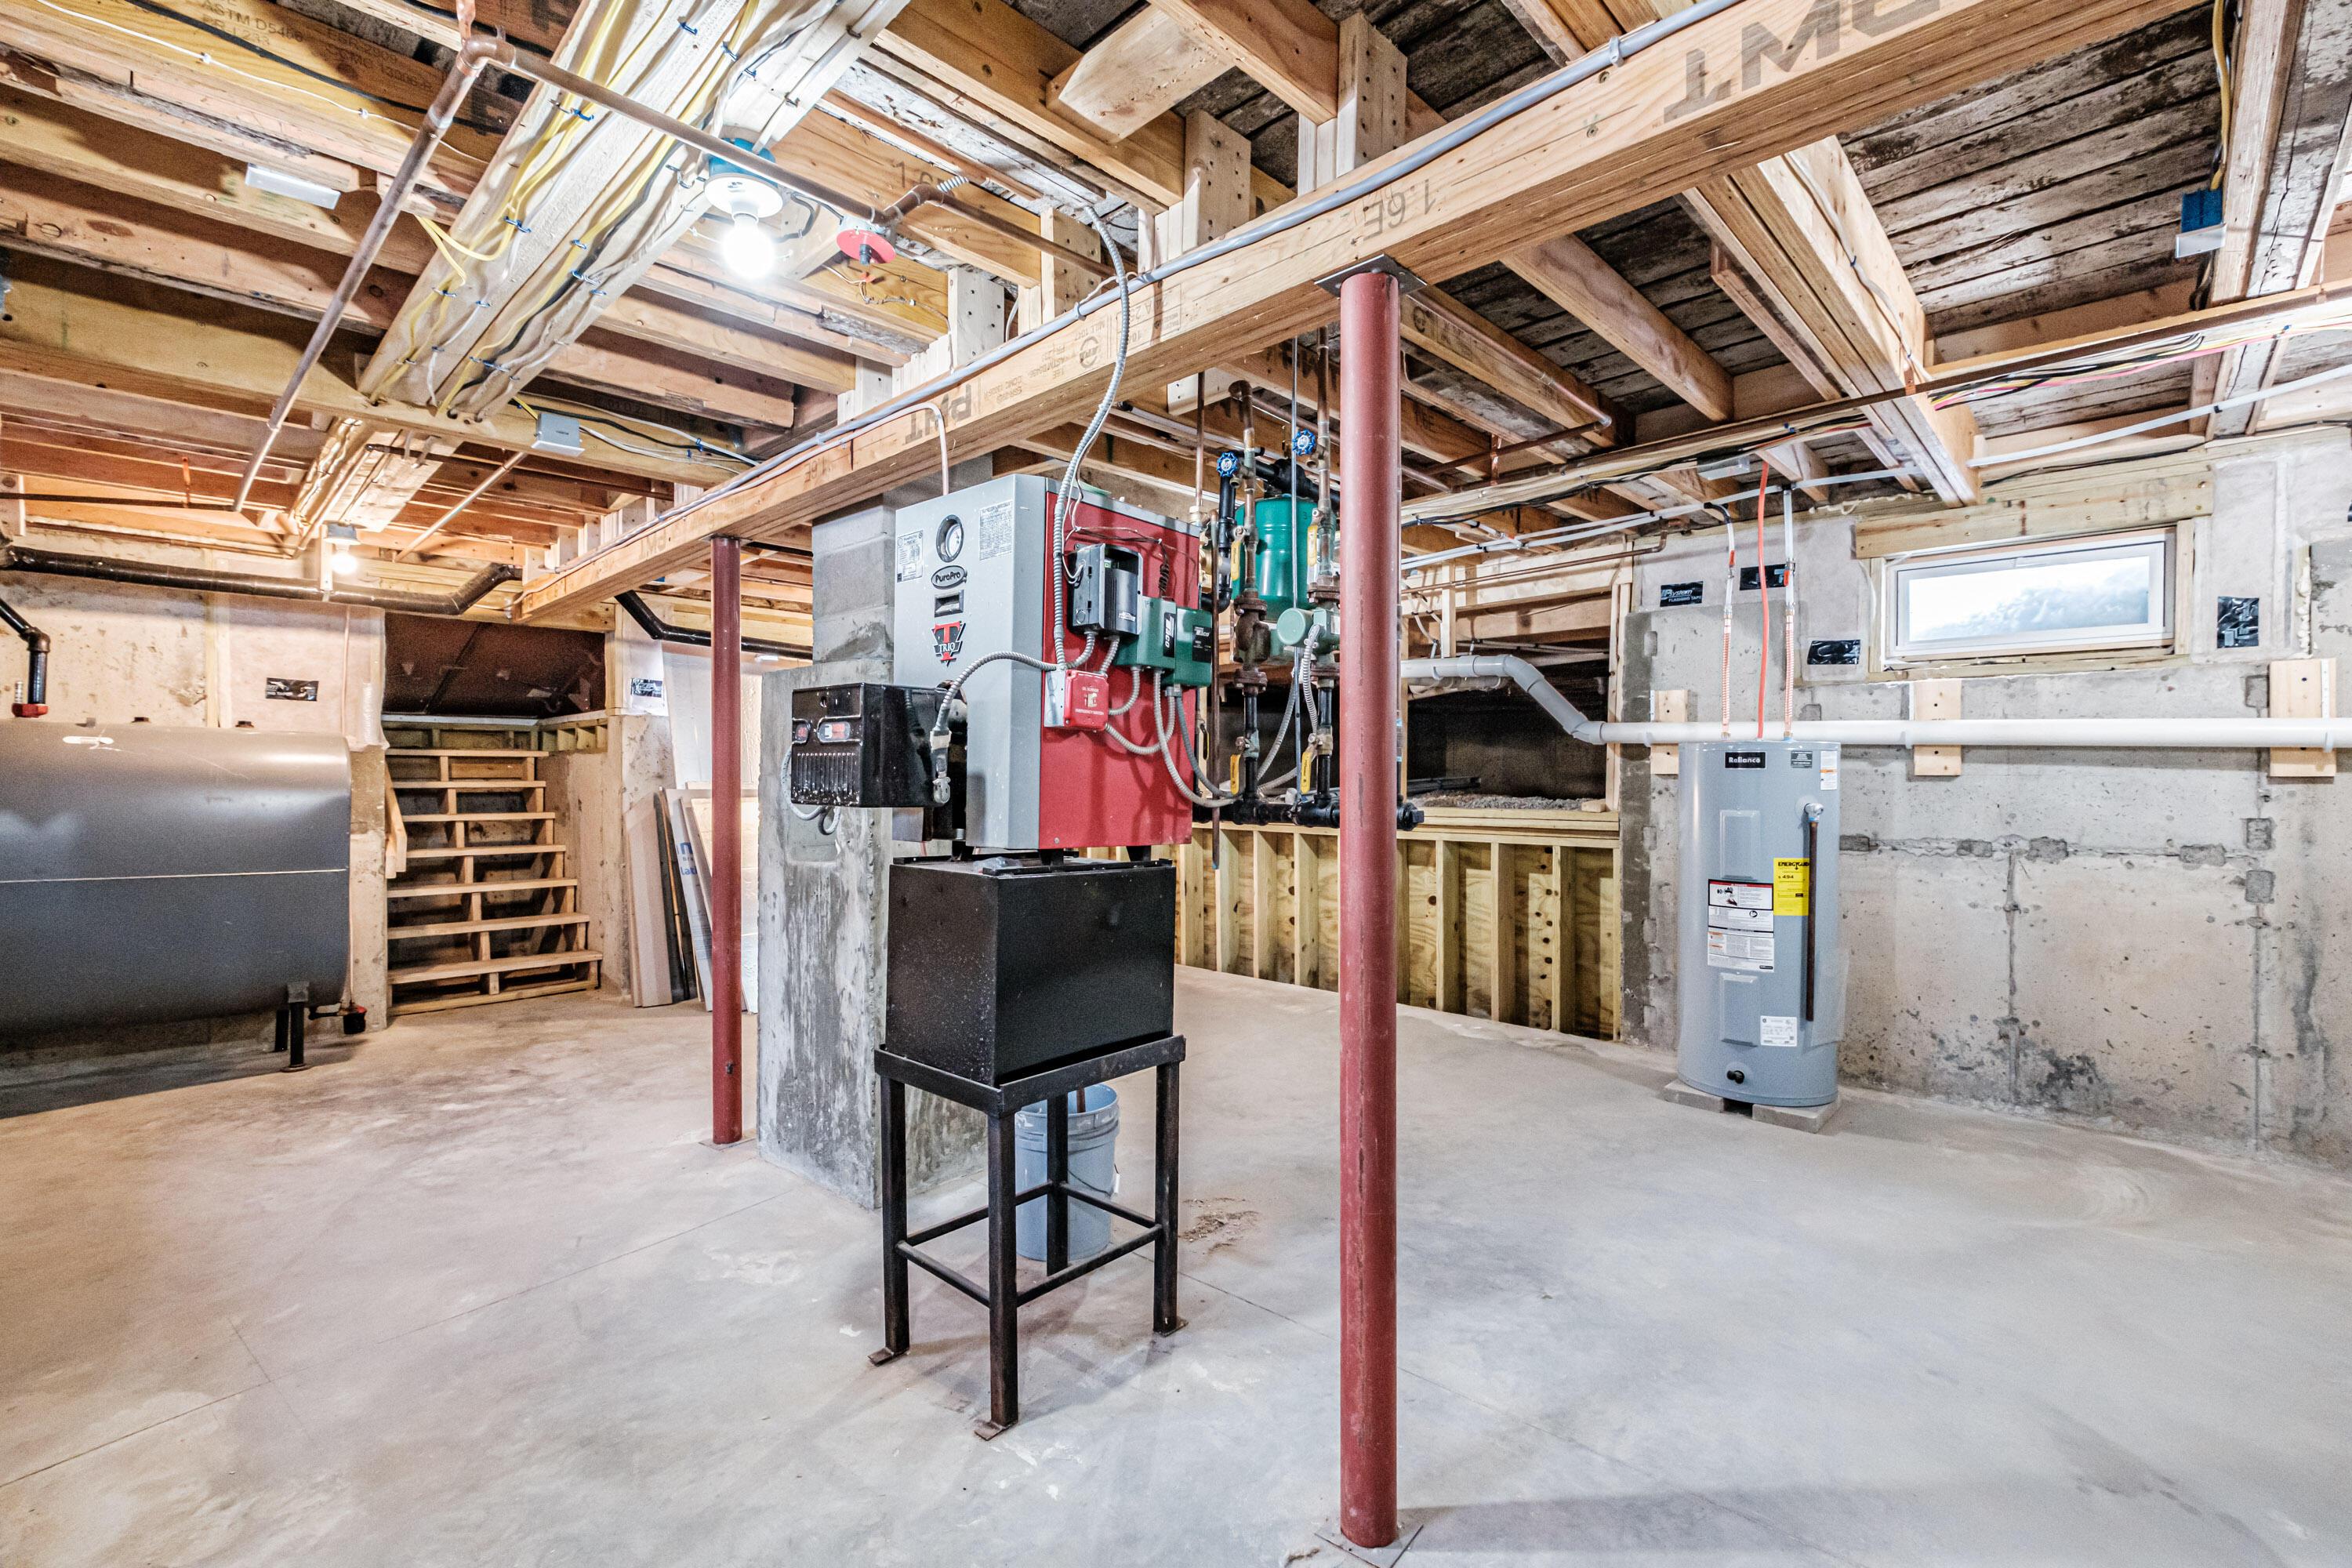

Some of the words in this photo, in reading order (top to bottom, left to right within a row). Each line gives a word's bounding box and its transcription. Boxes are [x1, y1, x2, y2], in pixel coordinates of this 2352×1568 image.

[1363, 179, 1436, 241] 1.6E
[935, 571, 961, 583] PurePro
[939, 643, 956, 652] TRIO
